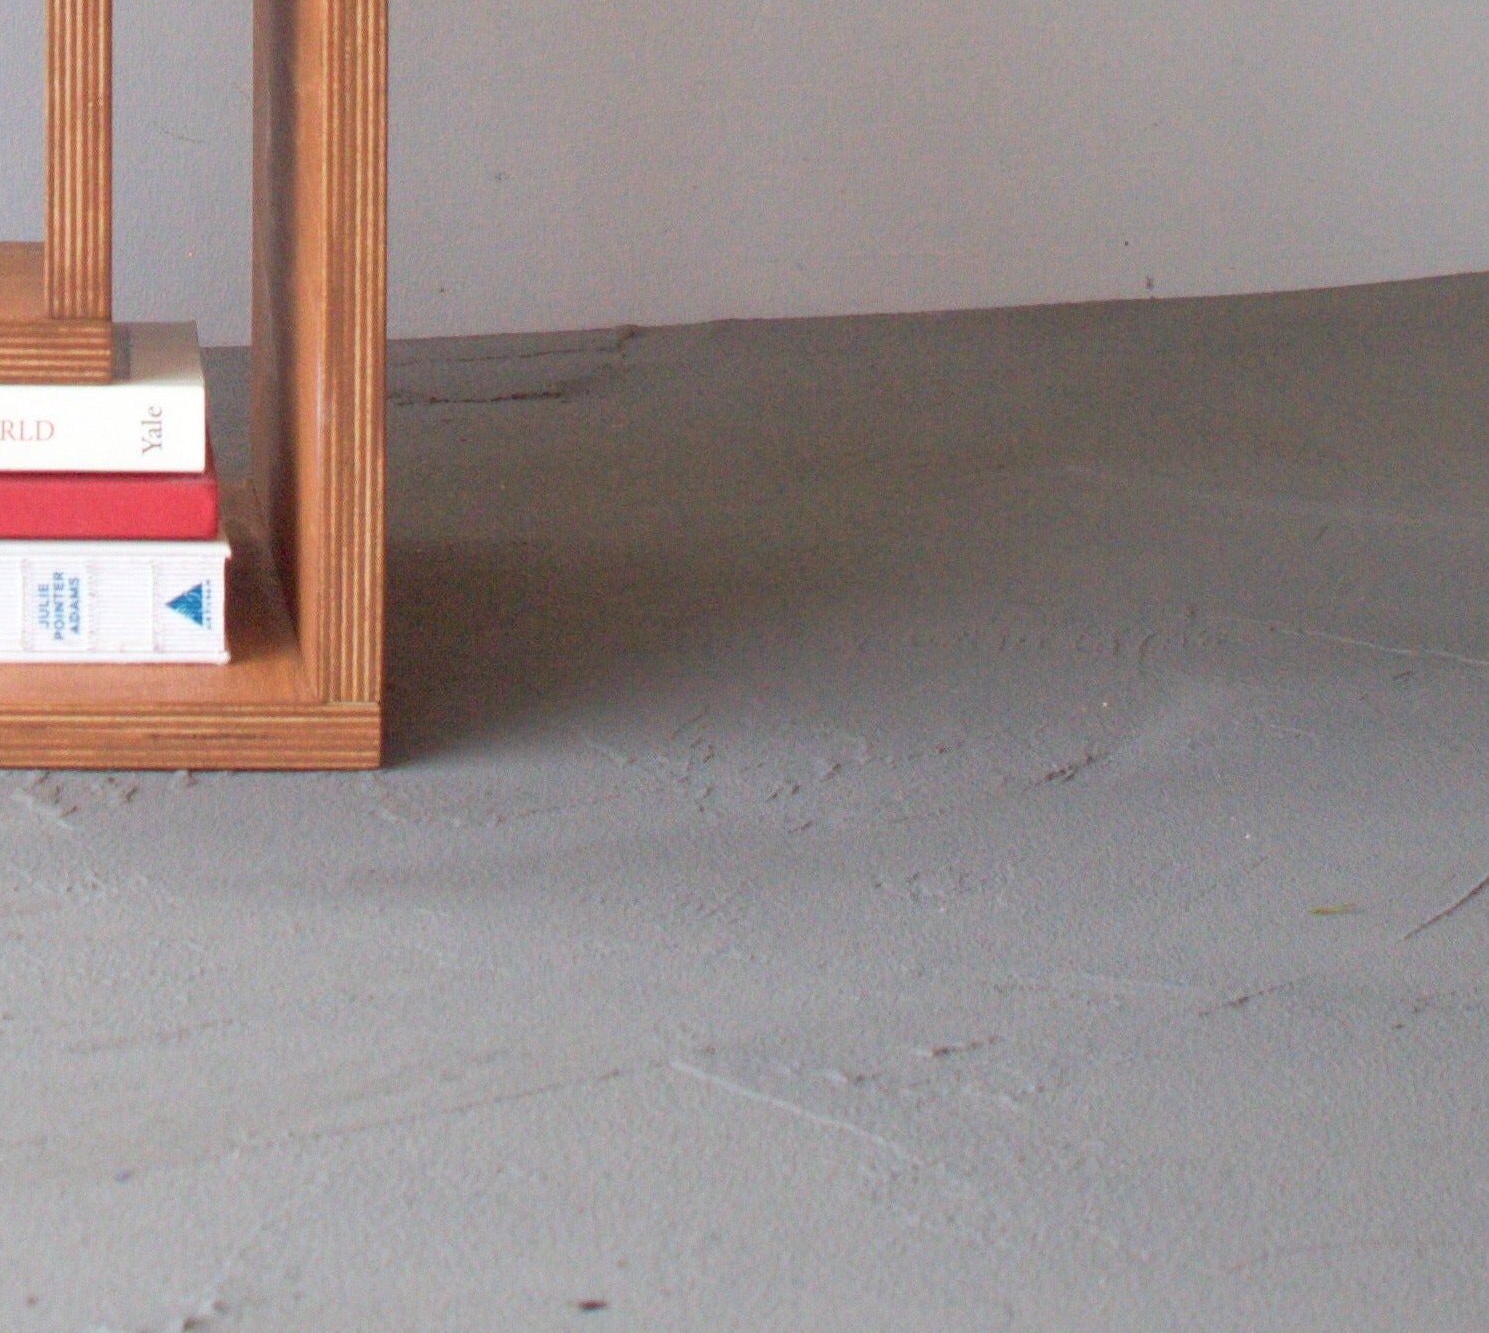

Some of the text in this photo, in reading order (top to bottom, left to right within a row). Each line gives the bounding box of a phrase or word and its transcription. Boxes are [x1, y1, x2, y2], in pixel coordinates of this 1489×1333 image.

[140, 404, 163, 455] Yale
[38, 583, 50, 628] JULIE
[53, 570, 65, 641] POINTER
[68, 576, 81, 635] ADAMS
